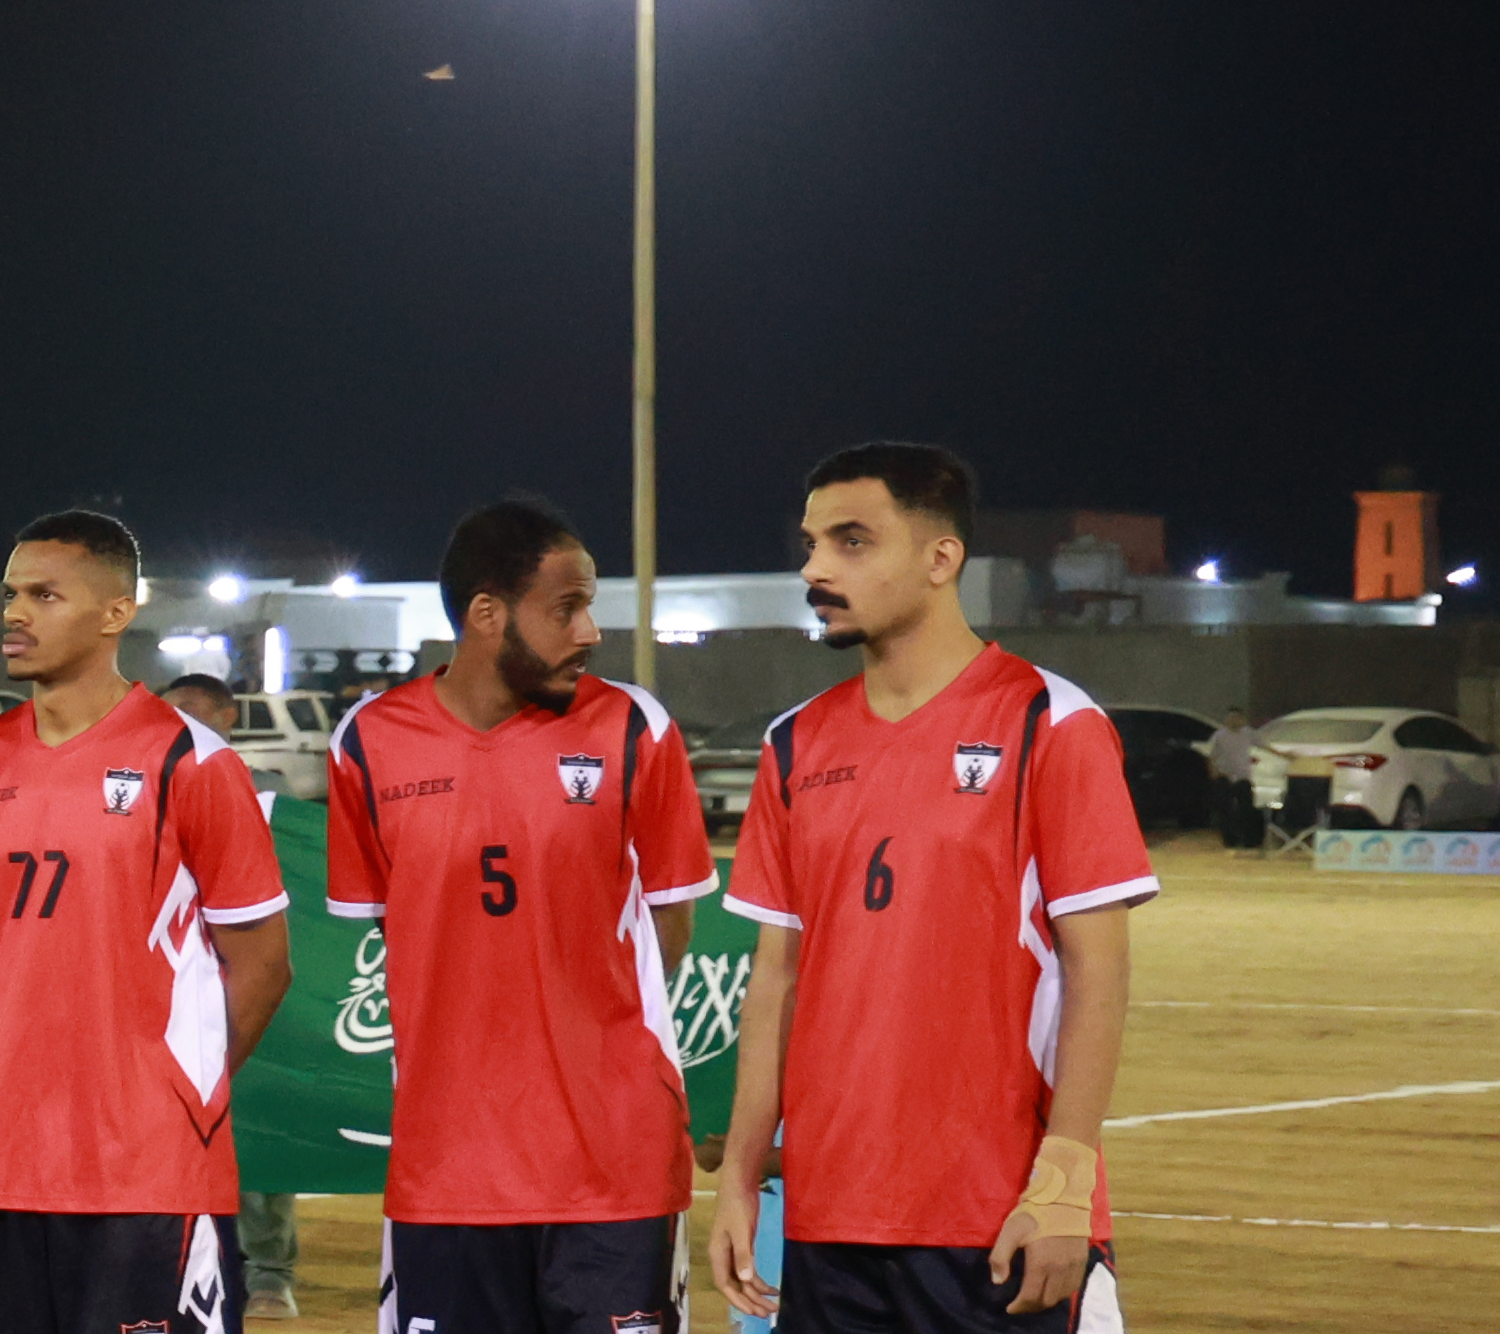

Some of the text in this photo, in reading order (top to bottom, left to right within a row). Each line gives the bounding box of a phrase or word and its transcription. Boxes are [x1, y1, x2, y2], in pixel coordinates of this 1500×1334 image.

[379, 777, 455, 804] NADEEK
[8, 850, 70, 919] 77
[481, 845, 518, 917] 5
[864, 836, 894, 912] 6
